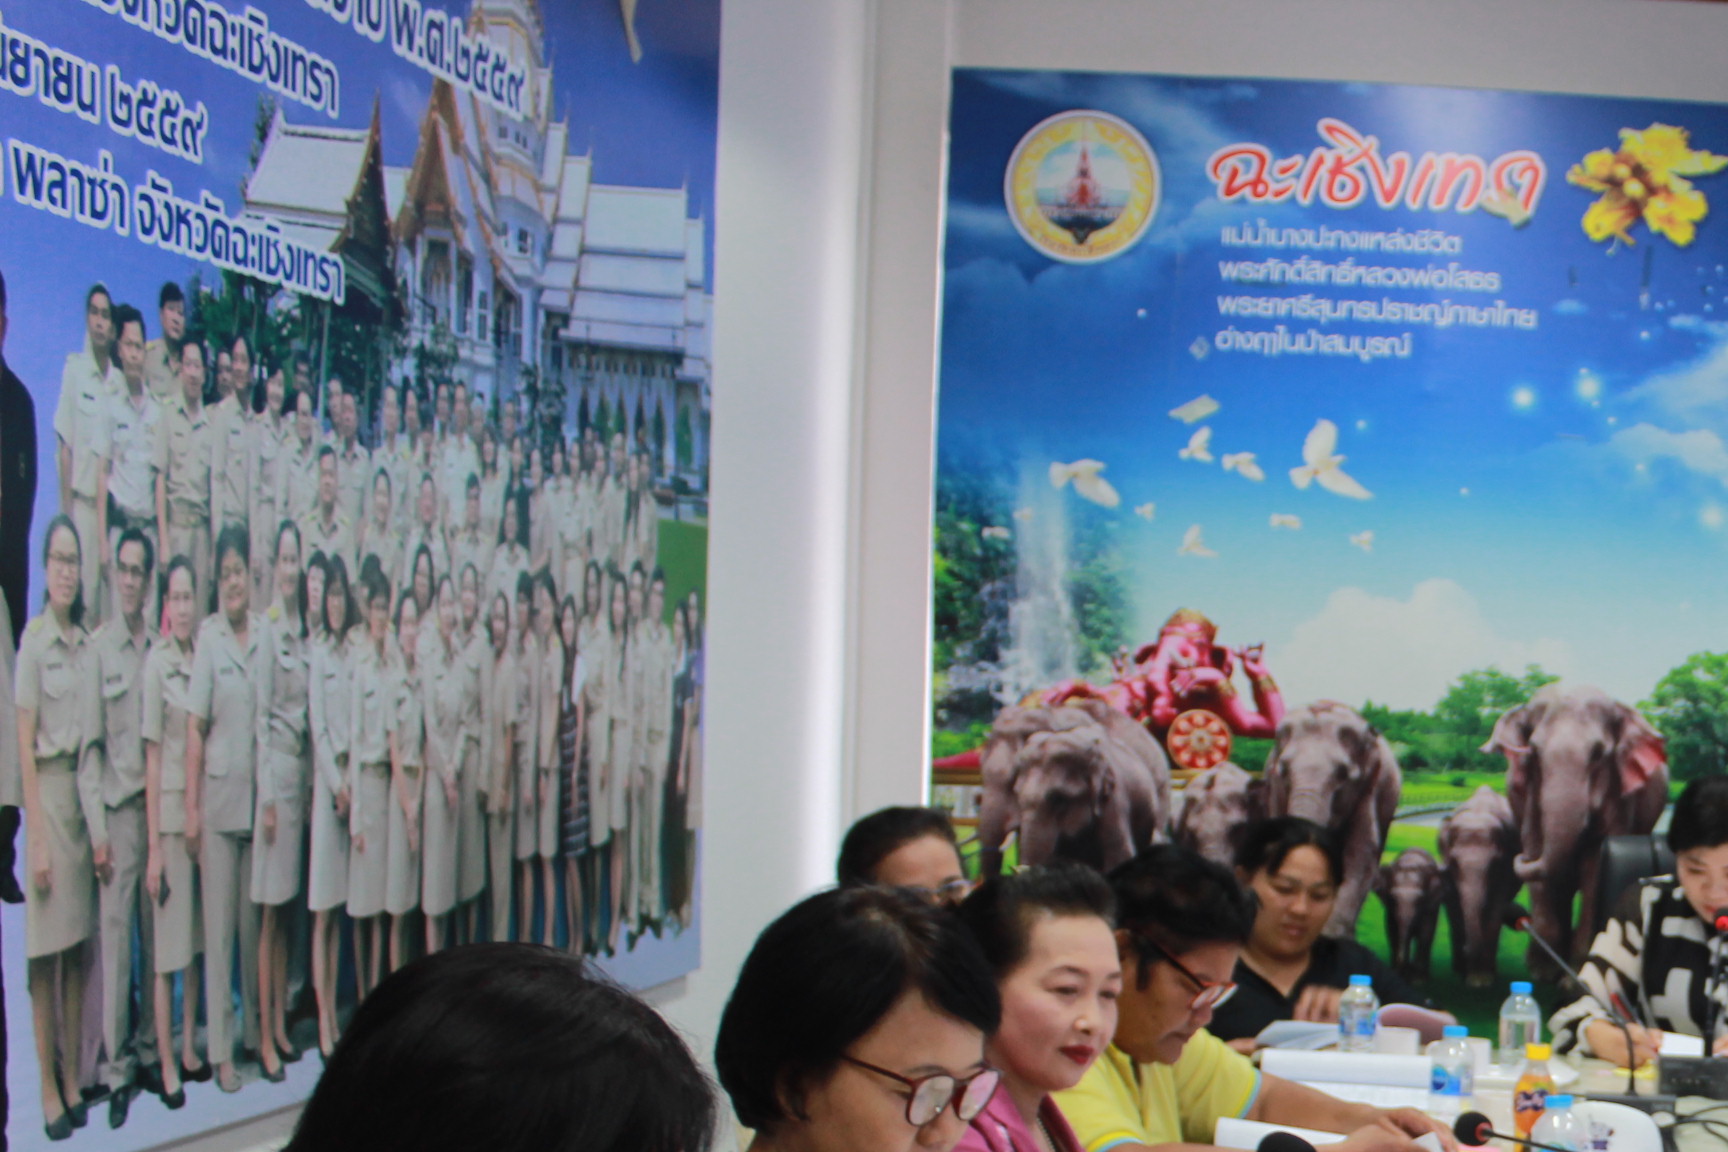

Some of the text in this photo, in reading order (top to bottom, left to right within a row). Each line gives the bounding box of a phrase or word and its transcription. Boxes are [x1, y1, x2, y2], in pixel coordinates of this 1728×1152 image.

[107, 70, 205, 156] ๒๕๕๙
[12, 144, 344, 299] พลาซ่า จังหวัดฉะเชิงเทรา
